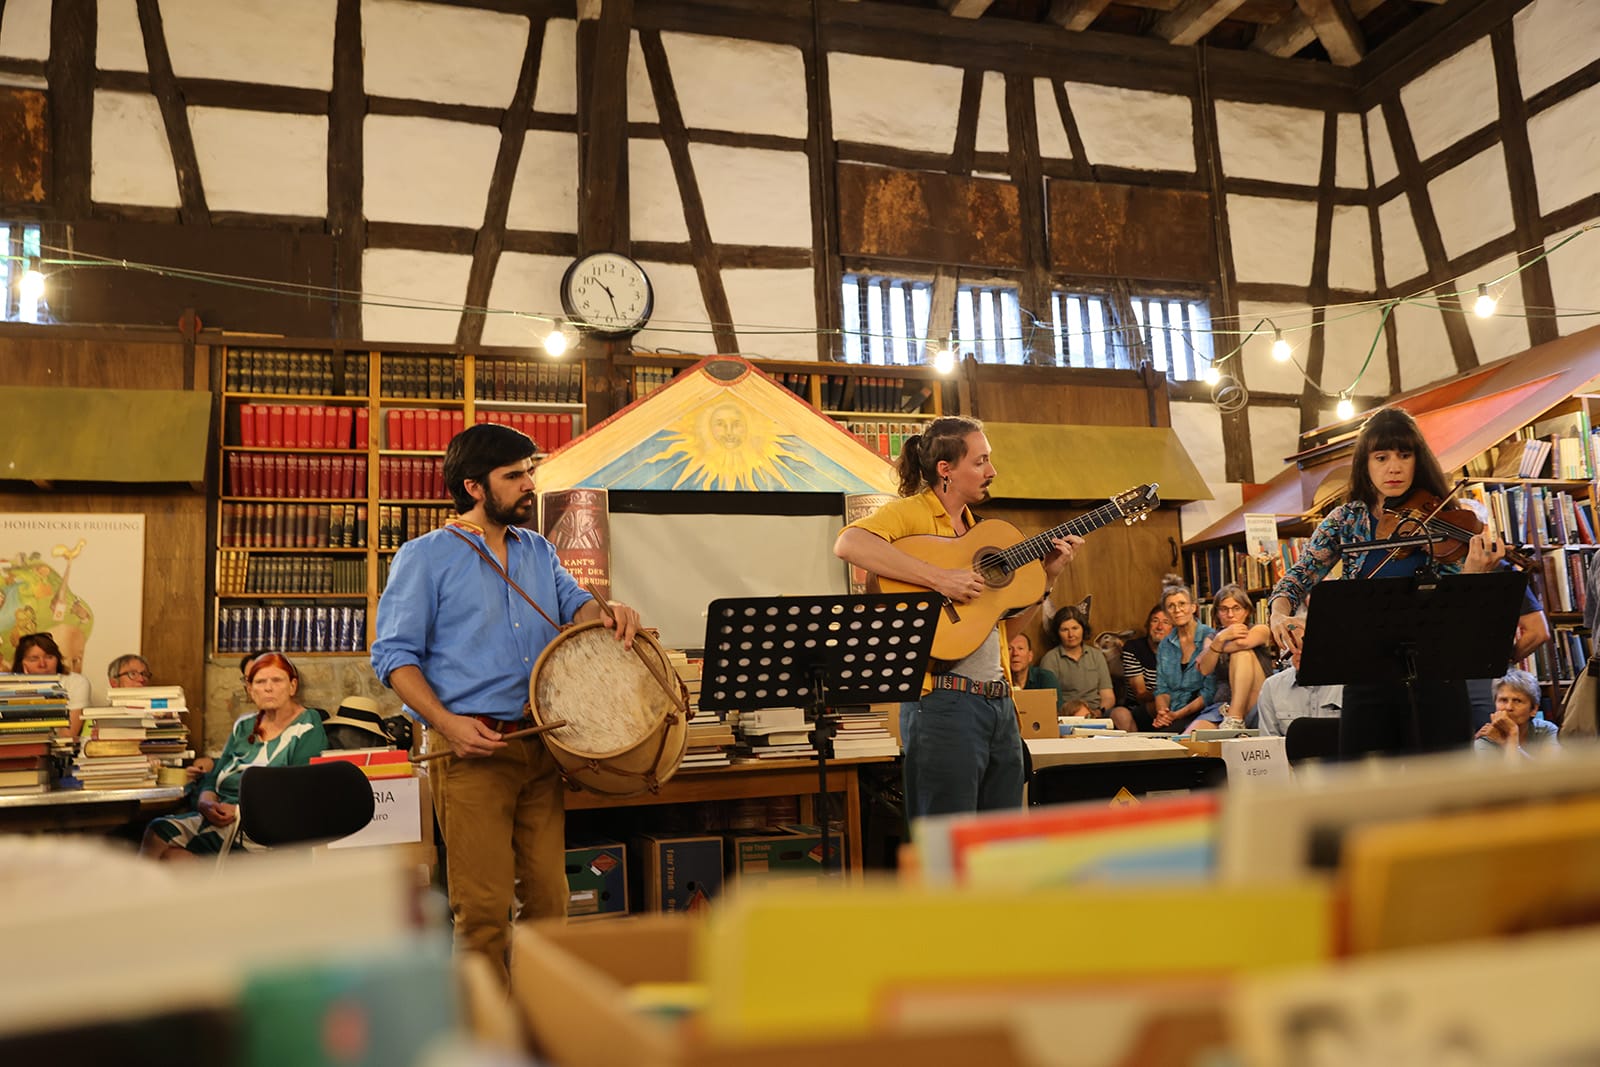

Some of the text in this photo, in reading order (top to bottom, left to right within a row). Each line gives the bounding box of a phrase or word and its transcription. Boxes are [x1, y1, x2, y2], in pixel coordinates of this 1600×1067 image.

[593, 266, 601, 276] 11
[604, 263, 615, 273] 12
[621, 268, 625, 277] 1
[583, 276, 594, 285] 10
[629, 277, 635, 287] 2
[578, 287, 586, 295] 9
[635, 290, 640, 300] 3
[583, 300, 590, 309] 8
[629, 303, 635, 312] 4
[594, 310, 600, 319] 7
[605, 314, 613, 323] 6
[621, 311, 627, 320] 5
[4, 520, 81, 529] HOHENECKER
[566, 567, 604, 576] ITIK DER
[1241, 749, 1271, 761] VARIA
[1252, 768, 1268, 776] Euro
[373, 791, 395, 804] RIA
[373, 813, 389, 821] uro
[666, 866, 677, 890] Trade
